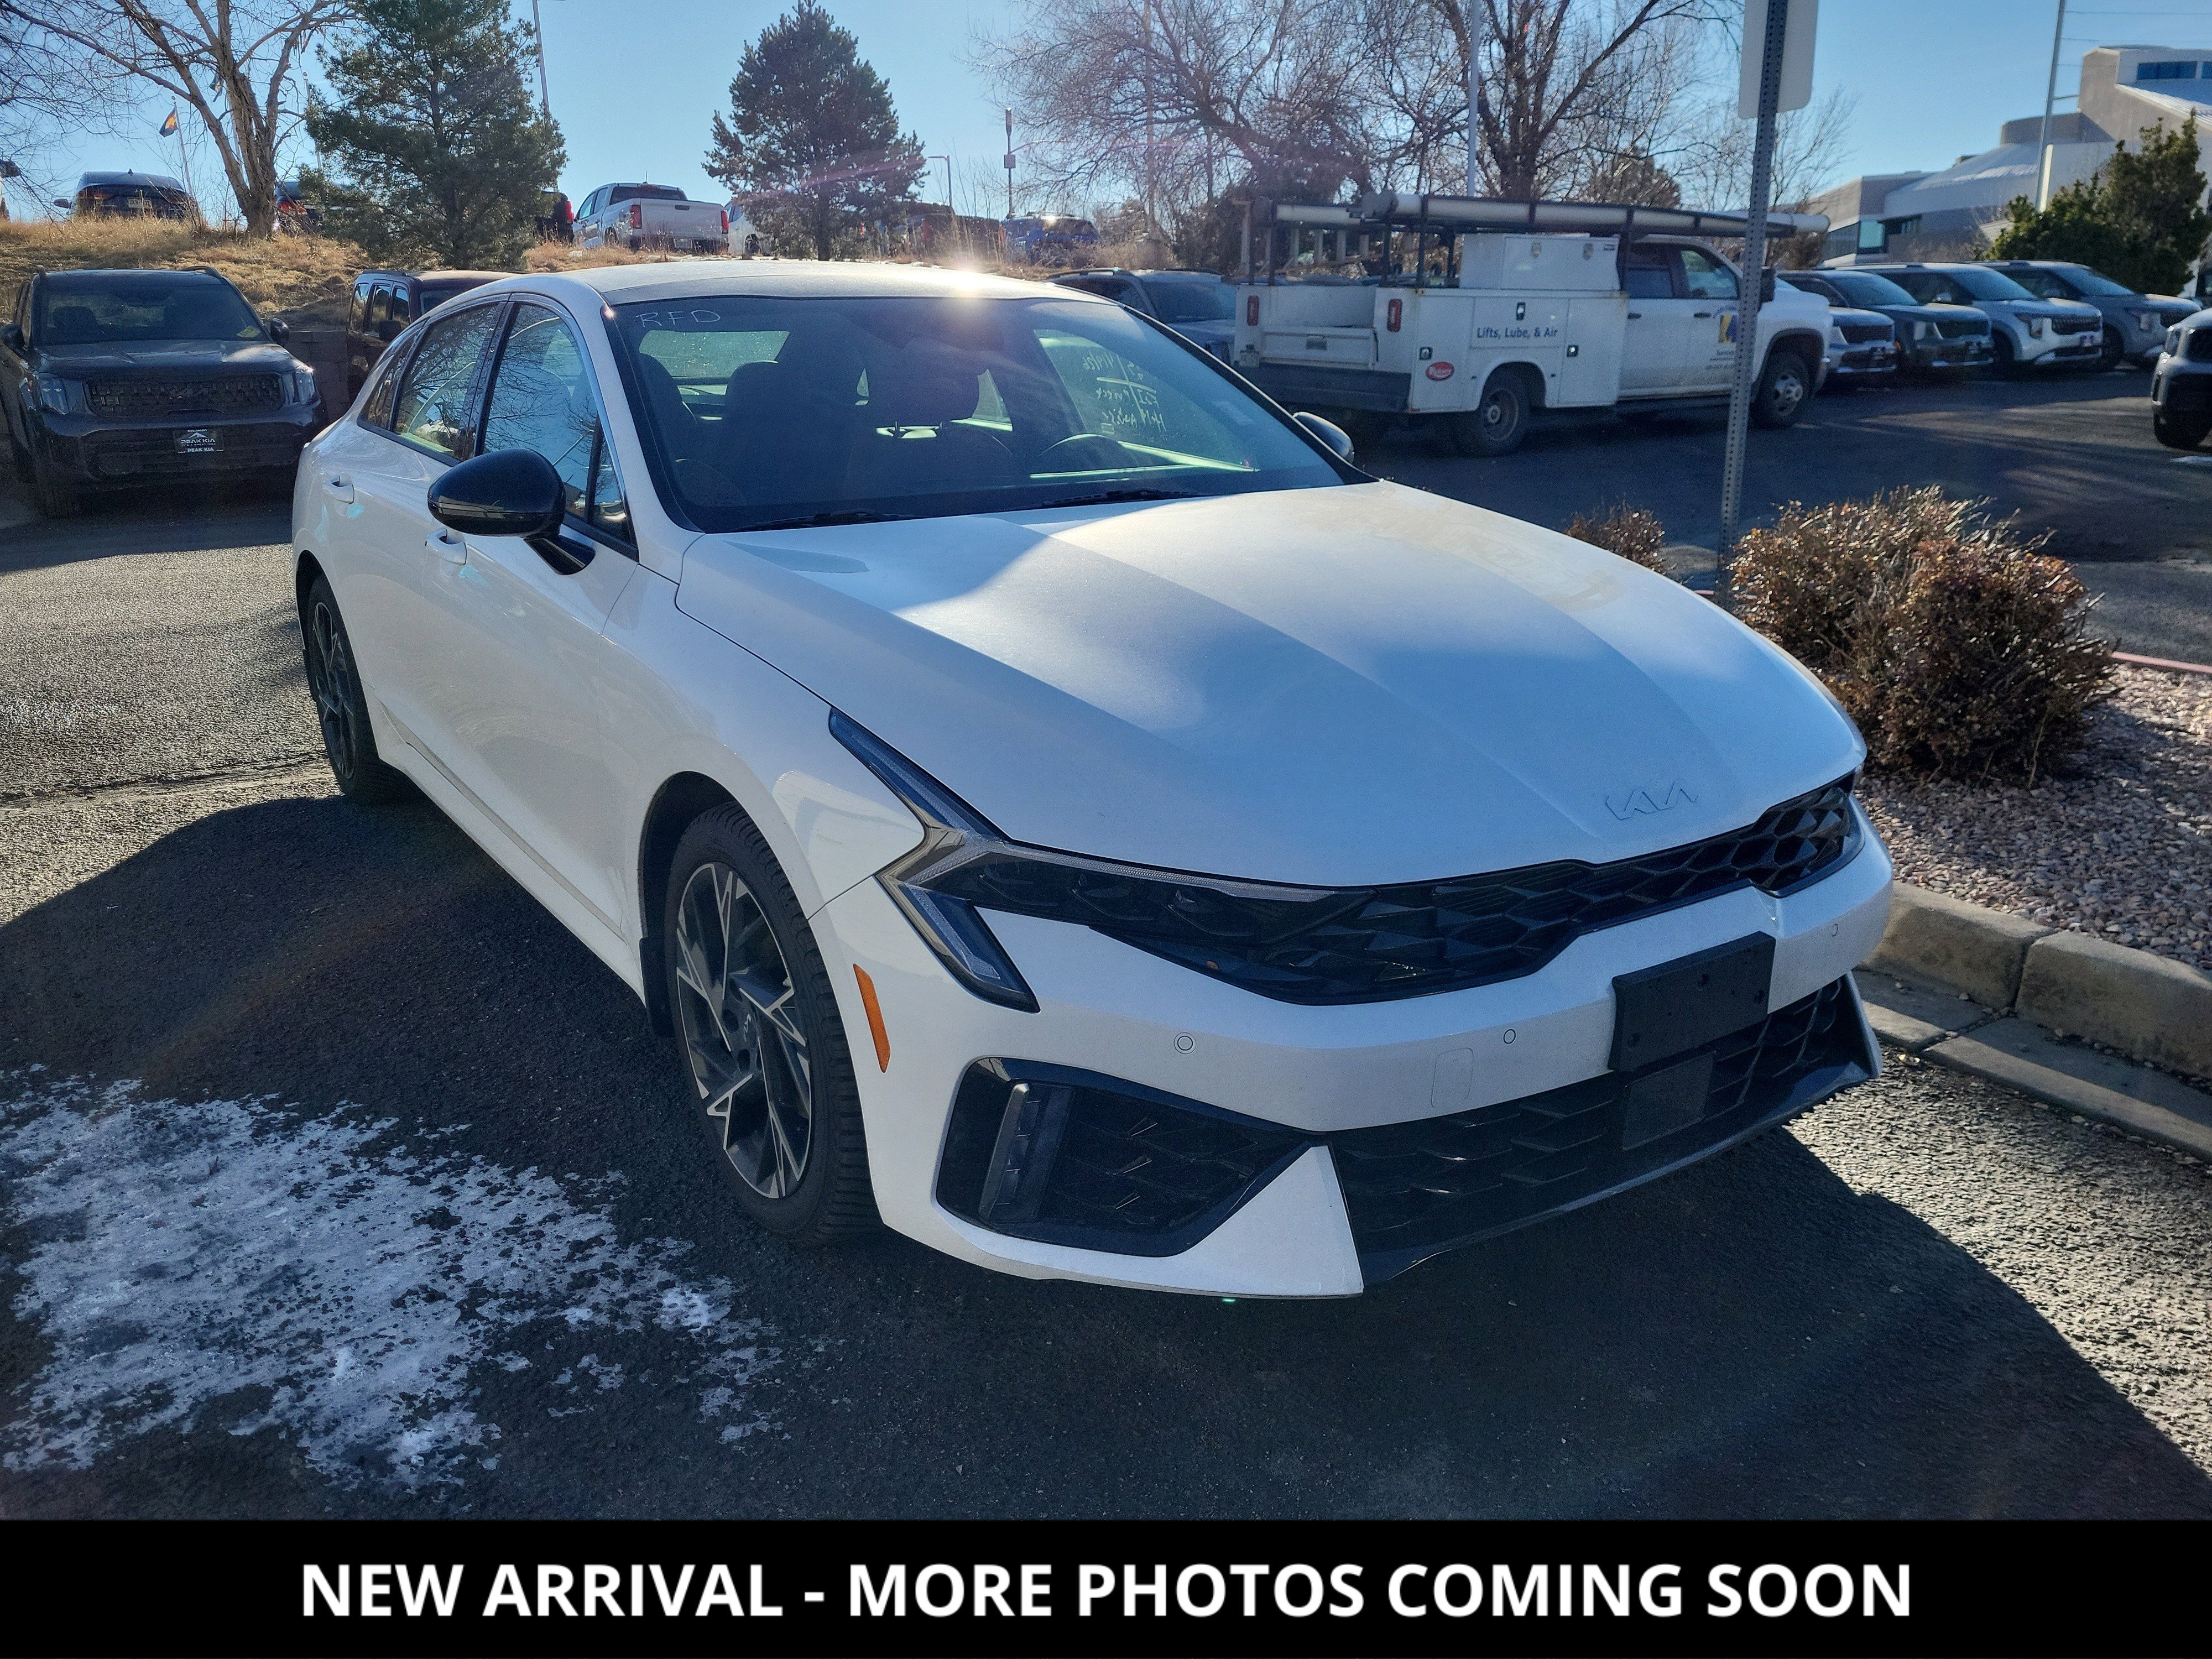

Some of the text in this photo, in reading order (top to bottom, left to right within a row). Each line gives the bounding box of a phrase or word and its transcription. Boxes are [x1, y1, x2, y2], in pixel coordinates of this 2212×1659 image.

[636, 310, 721, 328] RFD
[1477, 327, 1559, 340] Lifts, Lube, & Air
